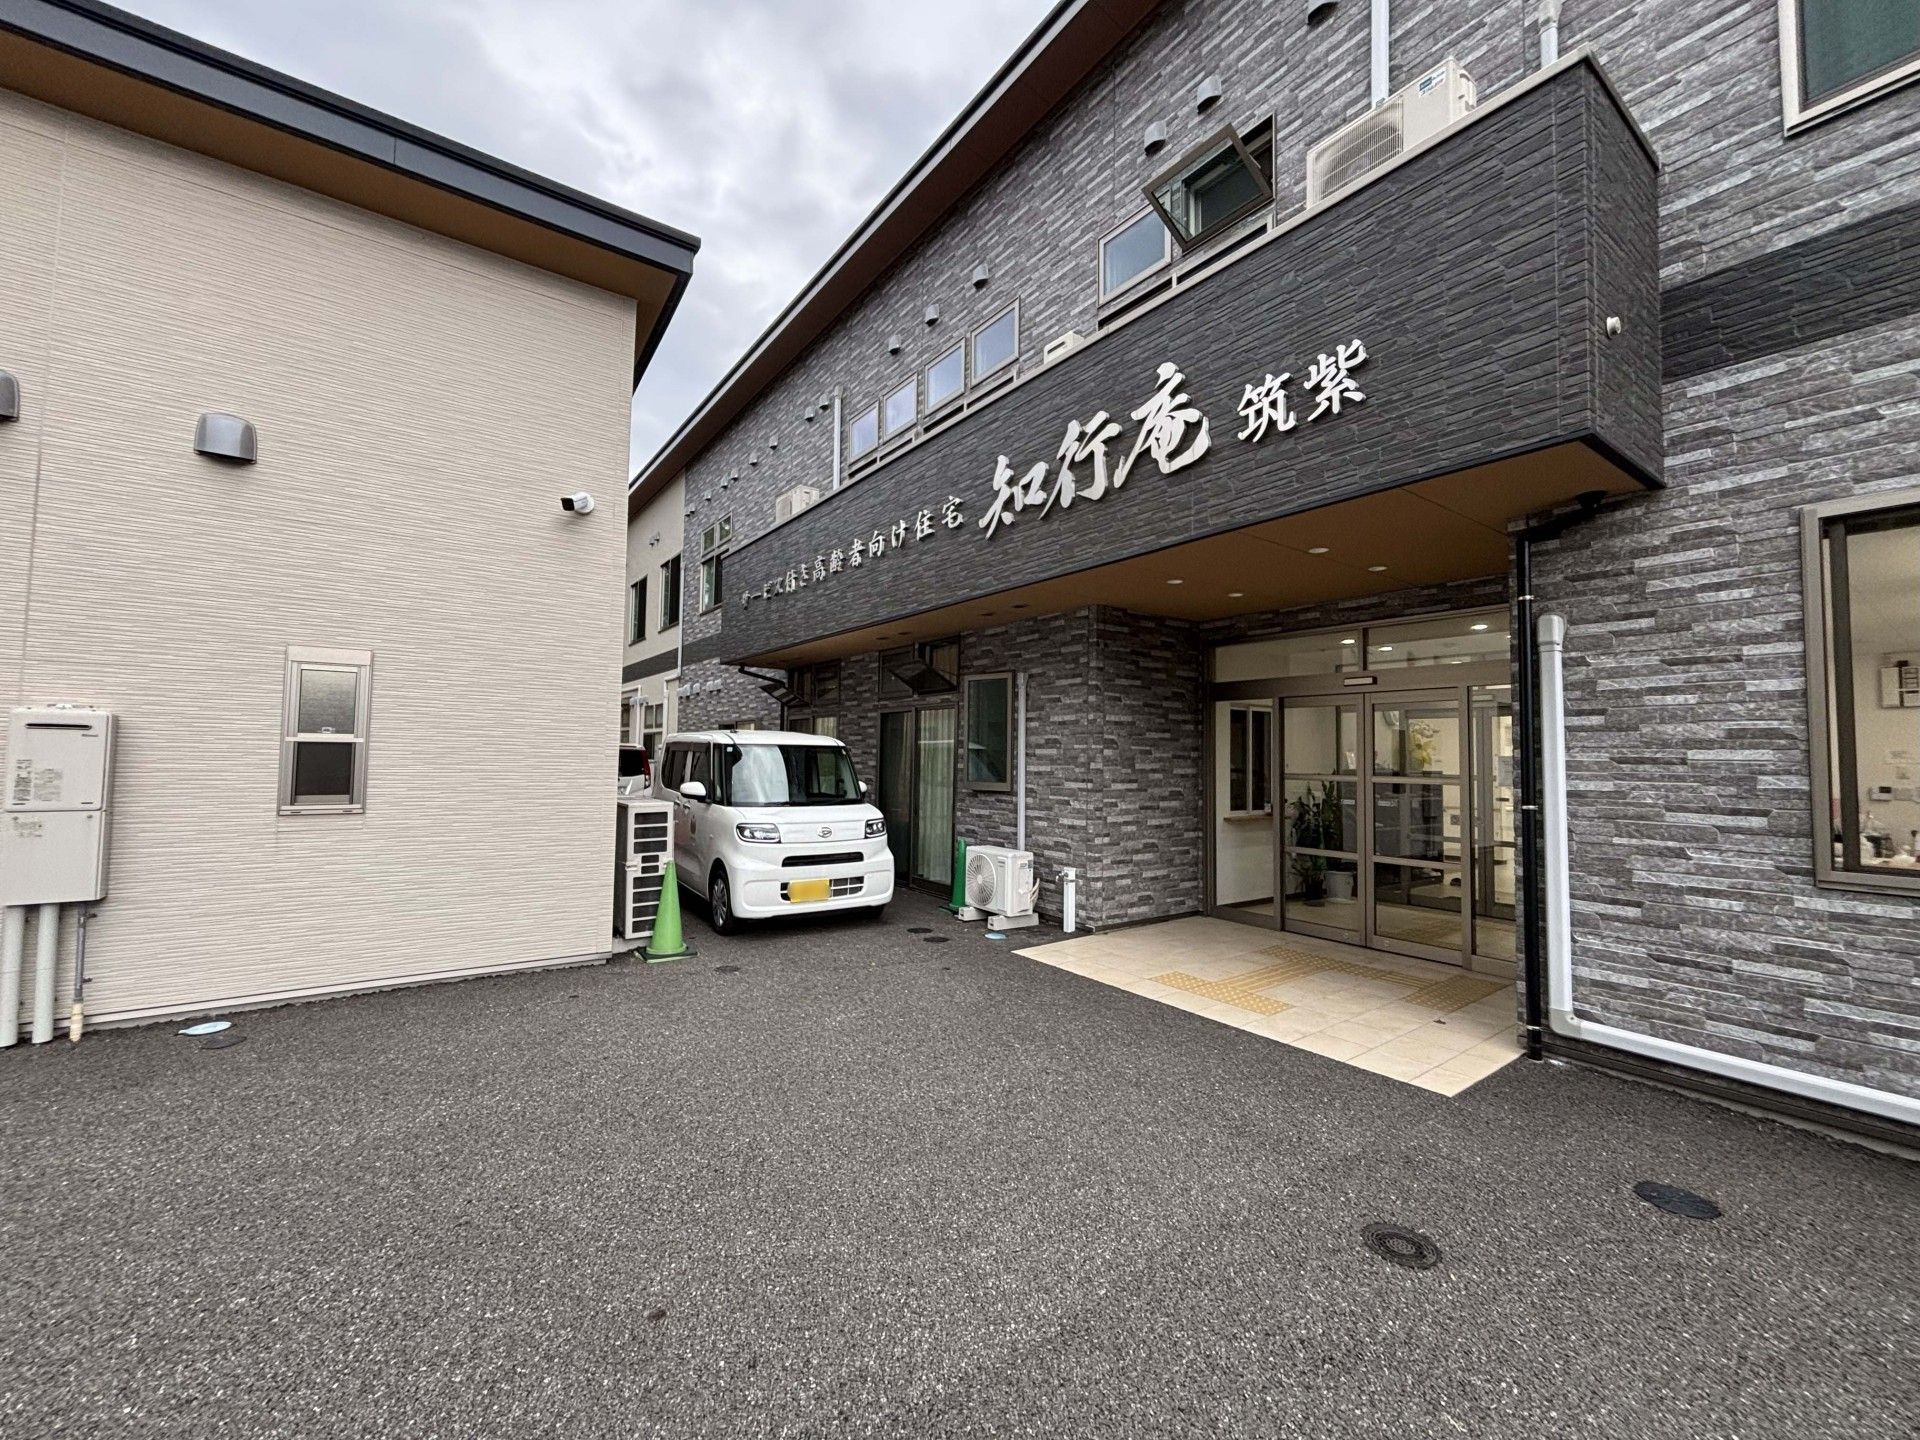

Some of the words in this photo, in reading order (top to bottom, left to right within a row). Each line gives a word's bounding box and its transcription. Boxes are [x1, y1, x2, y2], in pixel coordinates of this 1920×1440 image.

[741, 495, 964, 609] サービス付き高齢者向け住宅
[977, 362, 1211, 538] 知行庵
[1237, 339, 1367, 443] 筑紫
